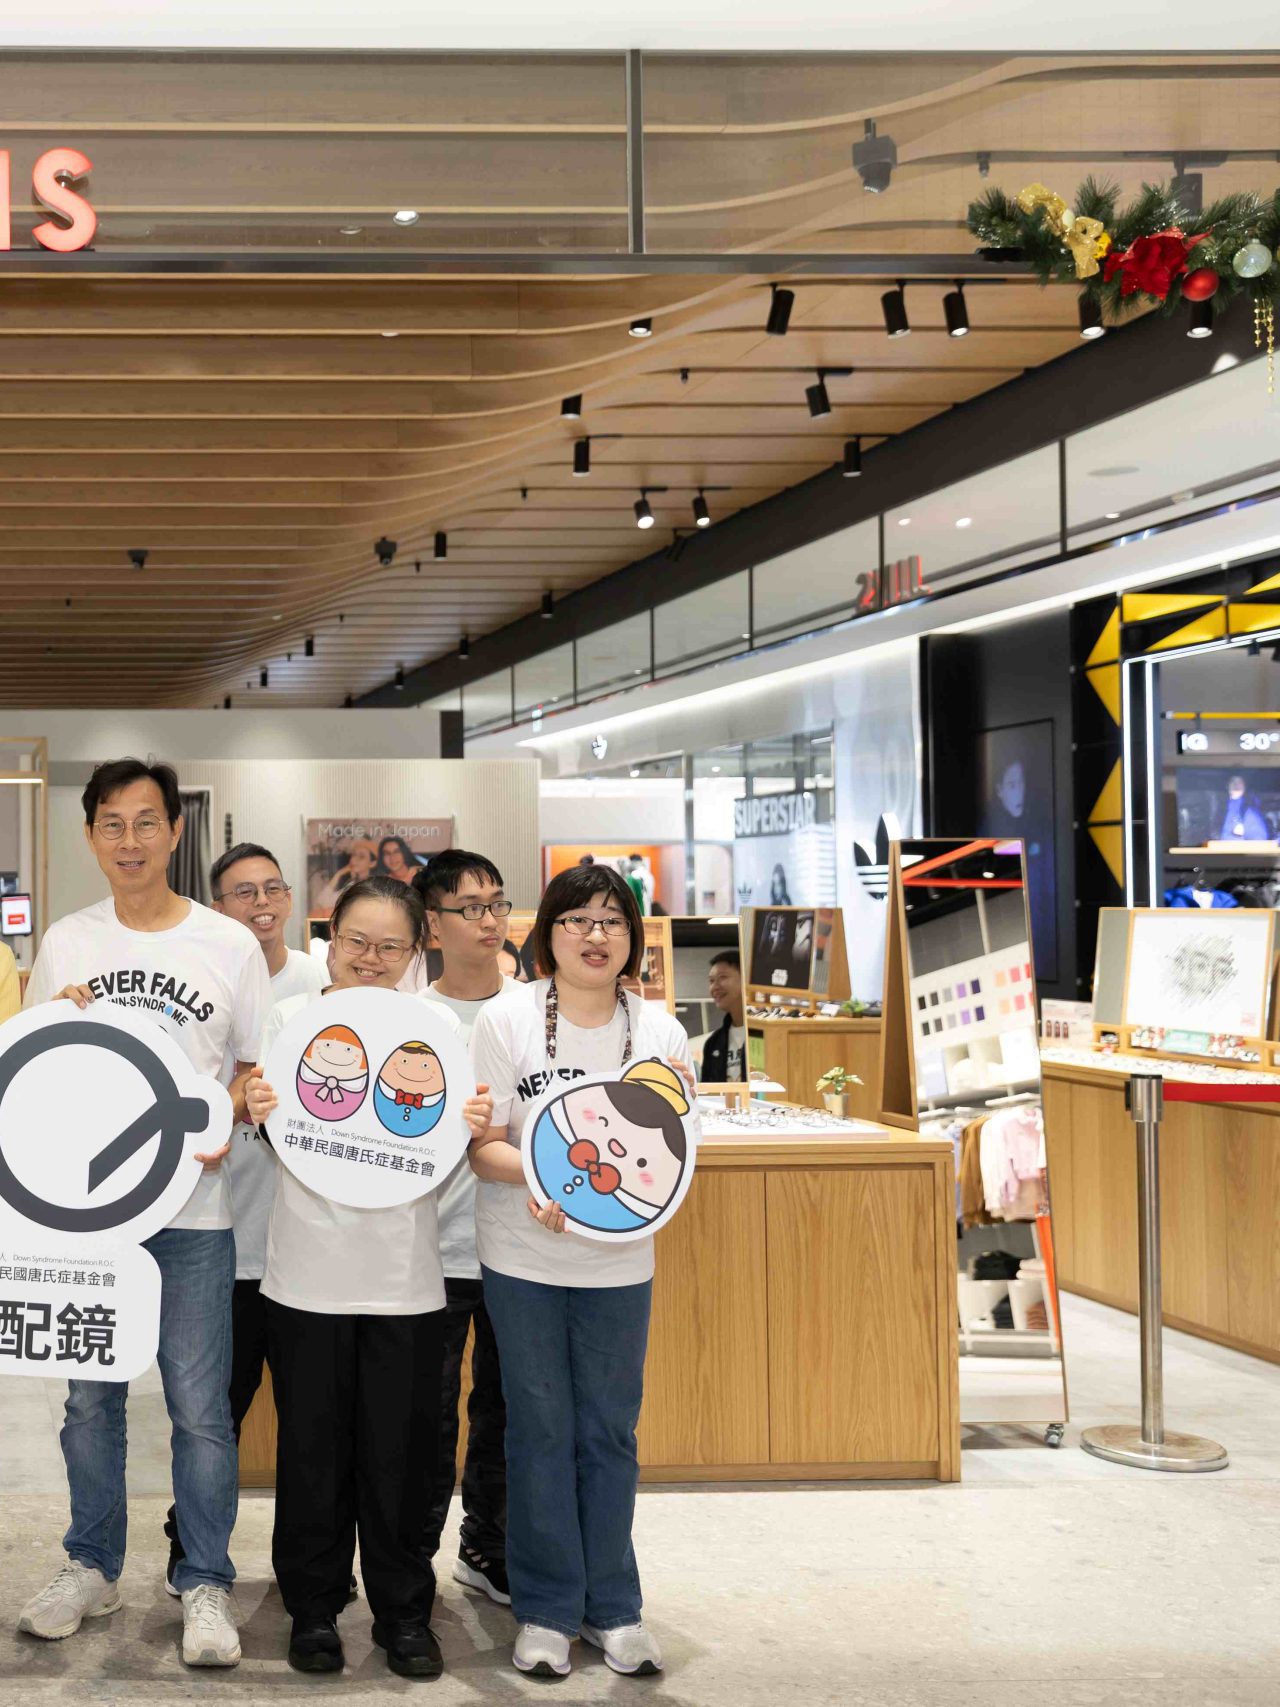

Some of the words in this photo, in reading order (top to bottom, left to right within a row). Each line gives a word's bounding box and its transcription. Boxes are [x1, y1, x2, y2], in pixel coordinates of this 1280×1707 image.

[318, 823, 364, 838] Made
[371, 824, 383, 837] in
[391, 823, 440, 841] Japan
[735, 793, 816, 835] SUPERSTAR
[88, 970, 146, 1000] EVER
[150, 972, 215, 1022] FALLS
[287, 1118, 325, 1136] 財團法人
[331, 1128, 350, 1139] Down
[350, 1131, 381, 1146] Syndrome
[383, 1139, 418, 1153] Foundation
[284, 1132, 436, 1178] 中華民國唐氏症基金會
[13, 1254, 32, 1262] Down
[32, 1255, 63, 1264] Syndrome
[63, 1257, 99, 1266] Foundation
